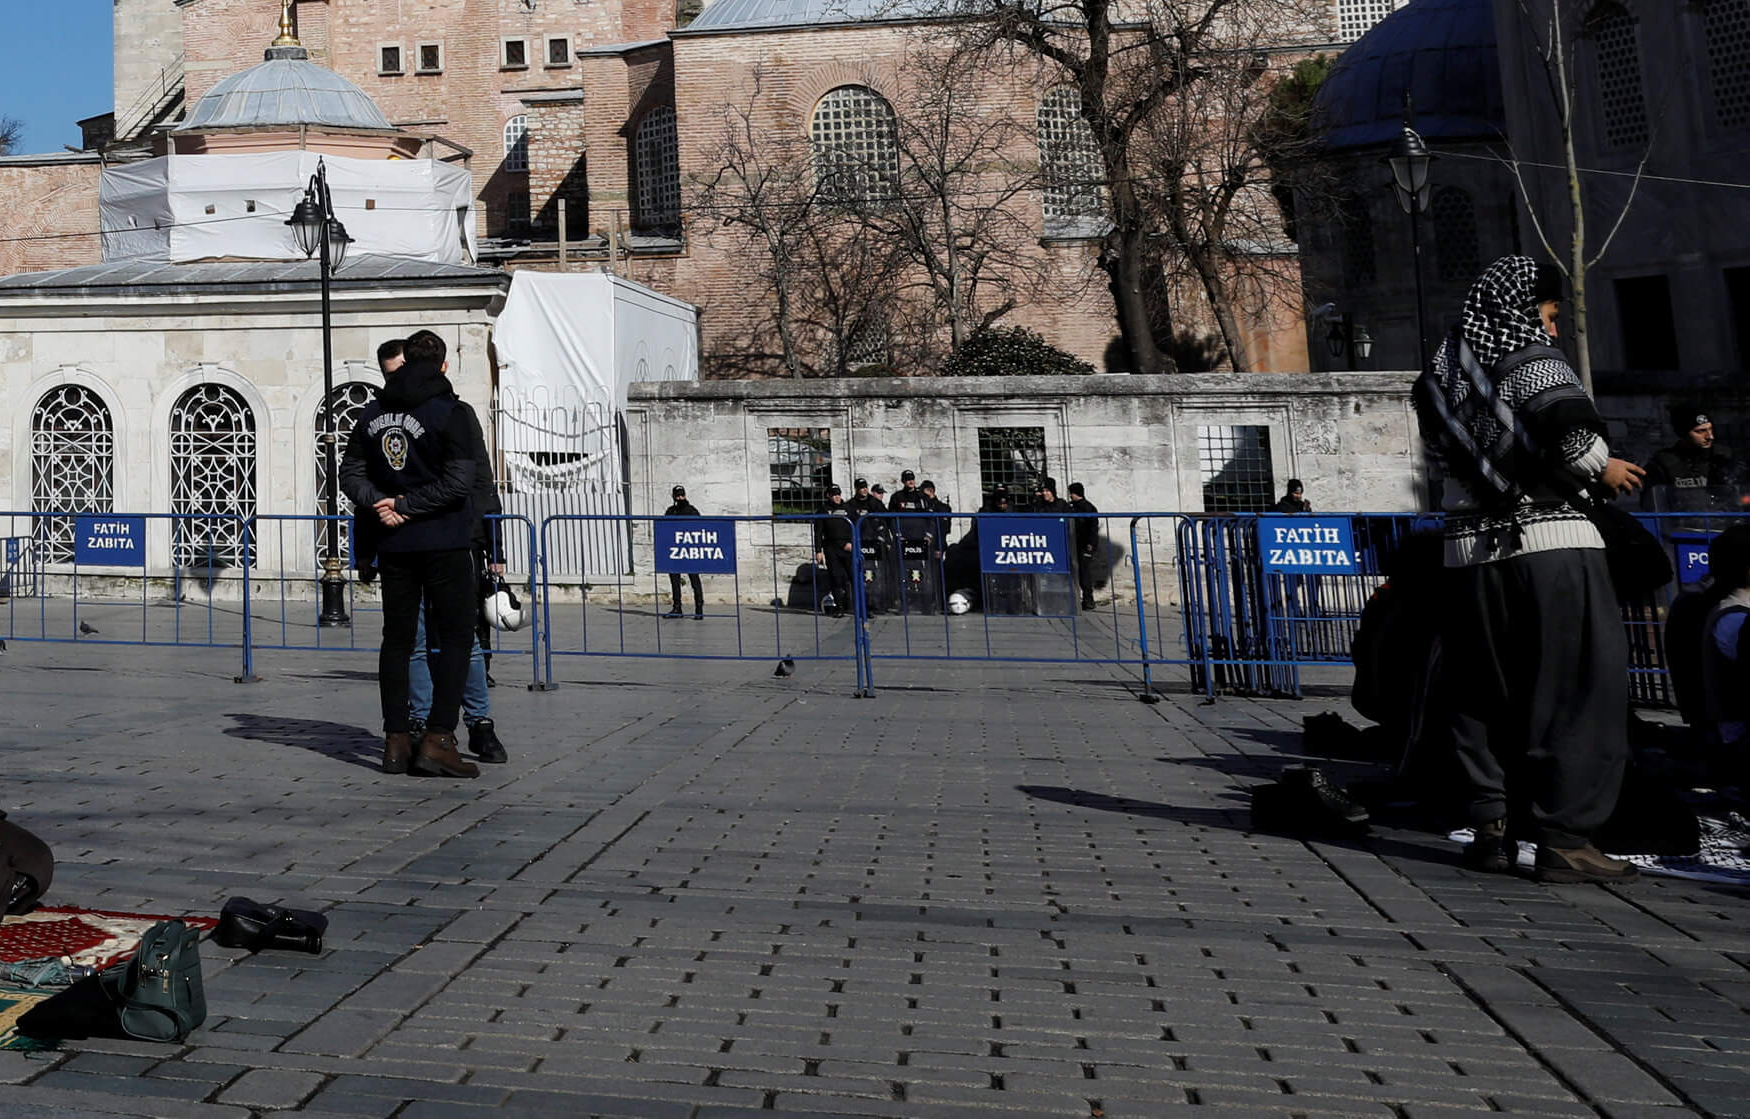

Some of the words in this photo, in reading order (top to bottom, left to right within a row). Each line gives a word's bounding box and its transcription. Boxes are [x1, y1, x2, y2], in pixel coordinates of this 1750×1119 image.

[93, 521, 130, 535] FATİH
[1274, 523, 1340, 544] FATİH
[87, 536, 134, 549] ZABITA
[674, 528, 717, 544] FATİH
[1000, 532, 1047, 548] FATİH
[669, 547, 724, 560] ZABITA
[994, 551, 1055, 565] ZABITA
[1269, 549, 1351, 566] ZABITA
